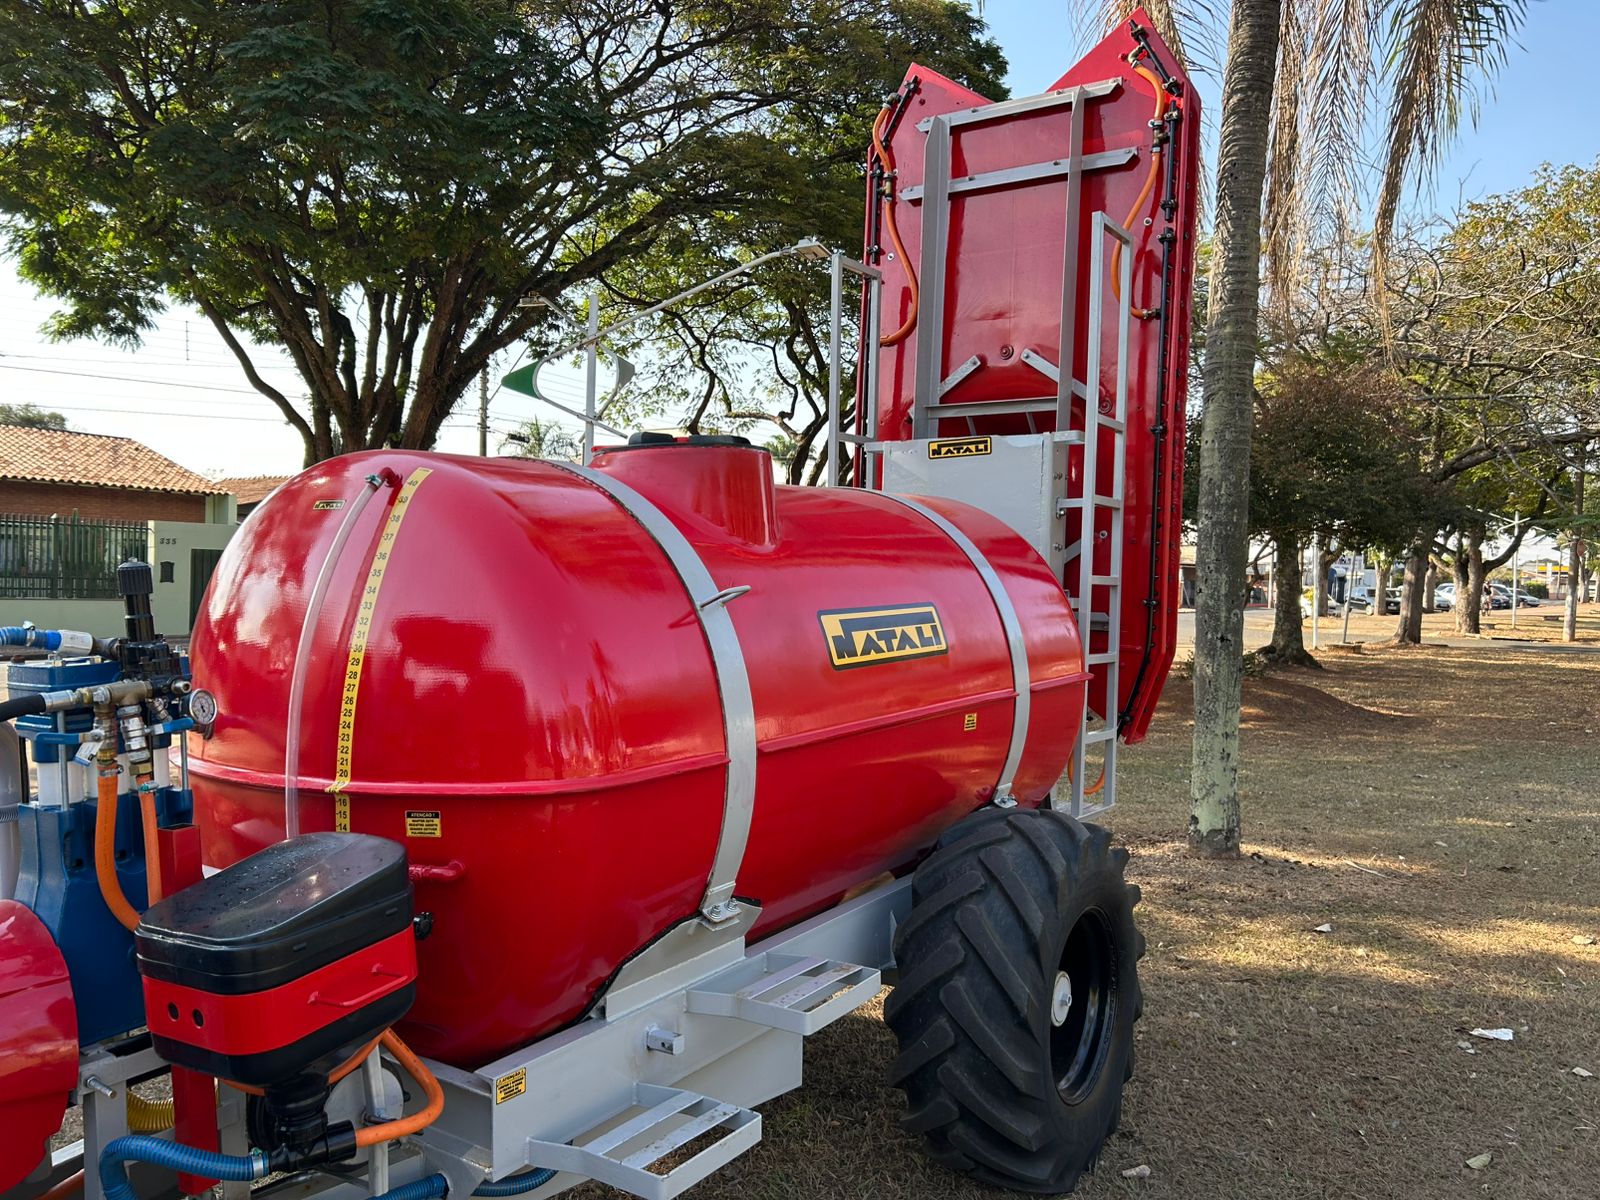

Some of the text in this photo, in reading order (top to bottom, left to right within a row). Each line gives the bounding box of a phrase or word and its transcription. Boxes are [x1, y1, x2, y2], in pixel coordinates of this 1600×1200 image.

[931, 440, 988, 456] NATALI
[408, 479, 419, 487] 40
[390, 514, 401, 522] 38
[159, 537, 177, 545] 335
[384, 533, 394, 541] 37
[377, 552, 387, 560] 36
[372, 569, 382, 577] 35
[367, 586, 377, 594] 34
[363, 601, 373, 610] 33
[359, 616, 369, 625] 32
[356, 630, 366, 639] 31
[831, 611, 943, 660] NATALI
[353, 644, 363, 653] 30
[350, 657, 360, 666] 29
[348, 671, 358, 680] 28
[346, 683, 356, 692] 27
[344, 696, 354, 705] 26
[343, 708, 353, 717] 25
[342, 720, 351, 729] 24
[341, 733, 350, 742] 23
[340, 745, 349, 754] 22
[340, 757, 349, 766] 21
[339, 769, 348, 778] 20
[339, 799, 348, 807] 16
[339, 811, 348, 819] 15
[339, 823, 348, 831] 14
